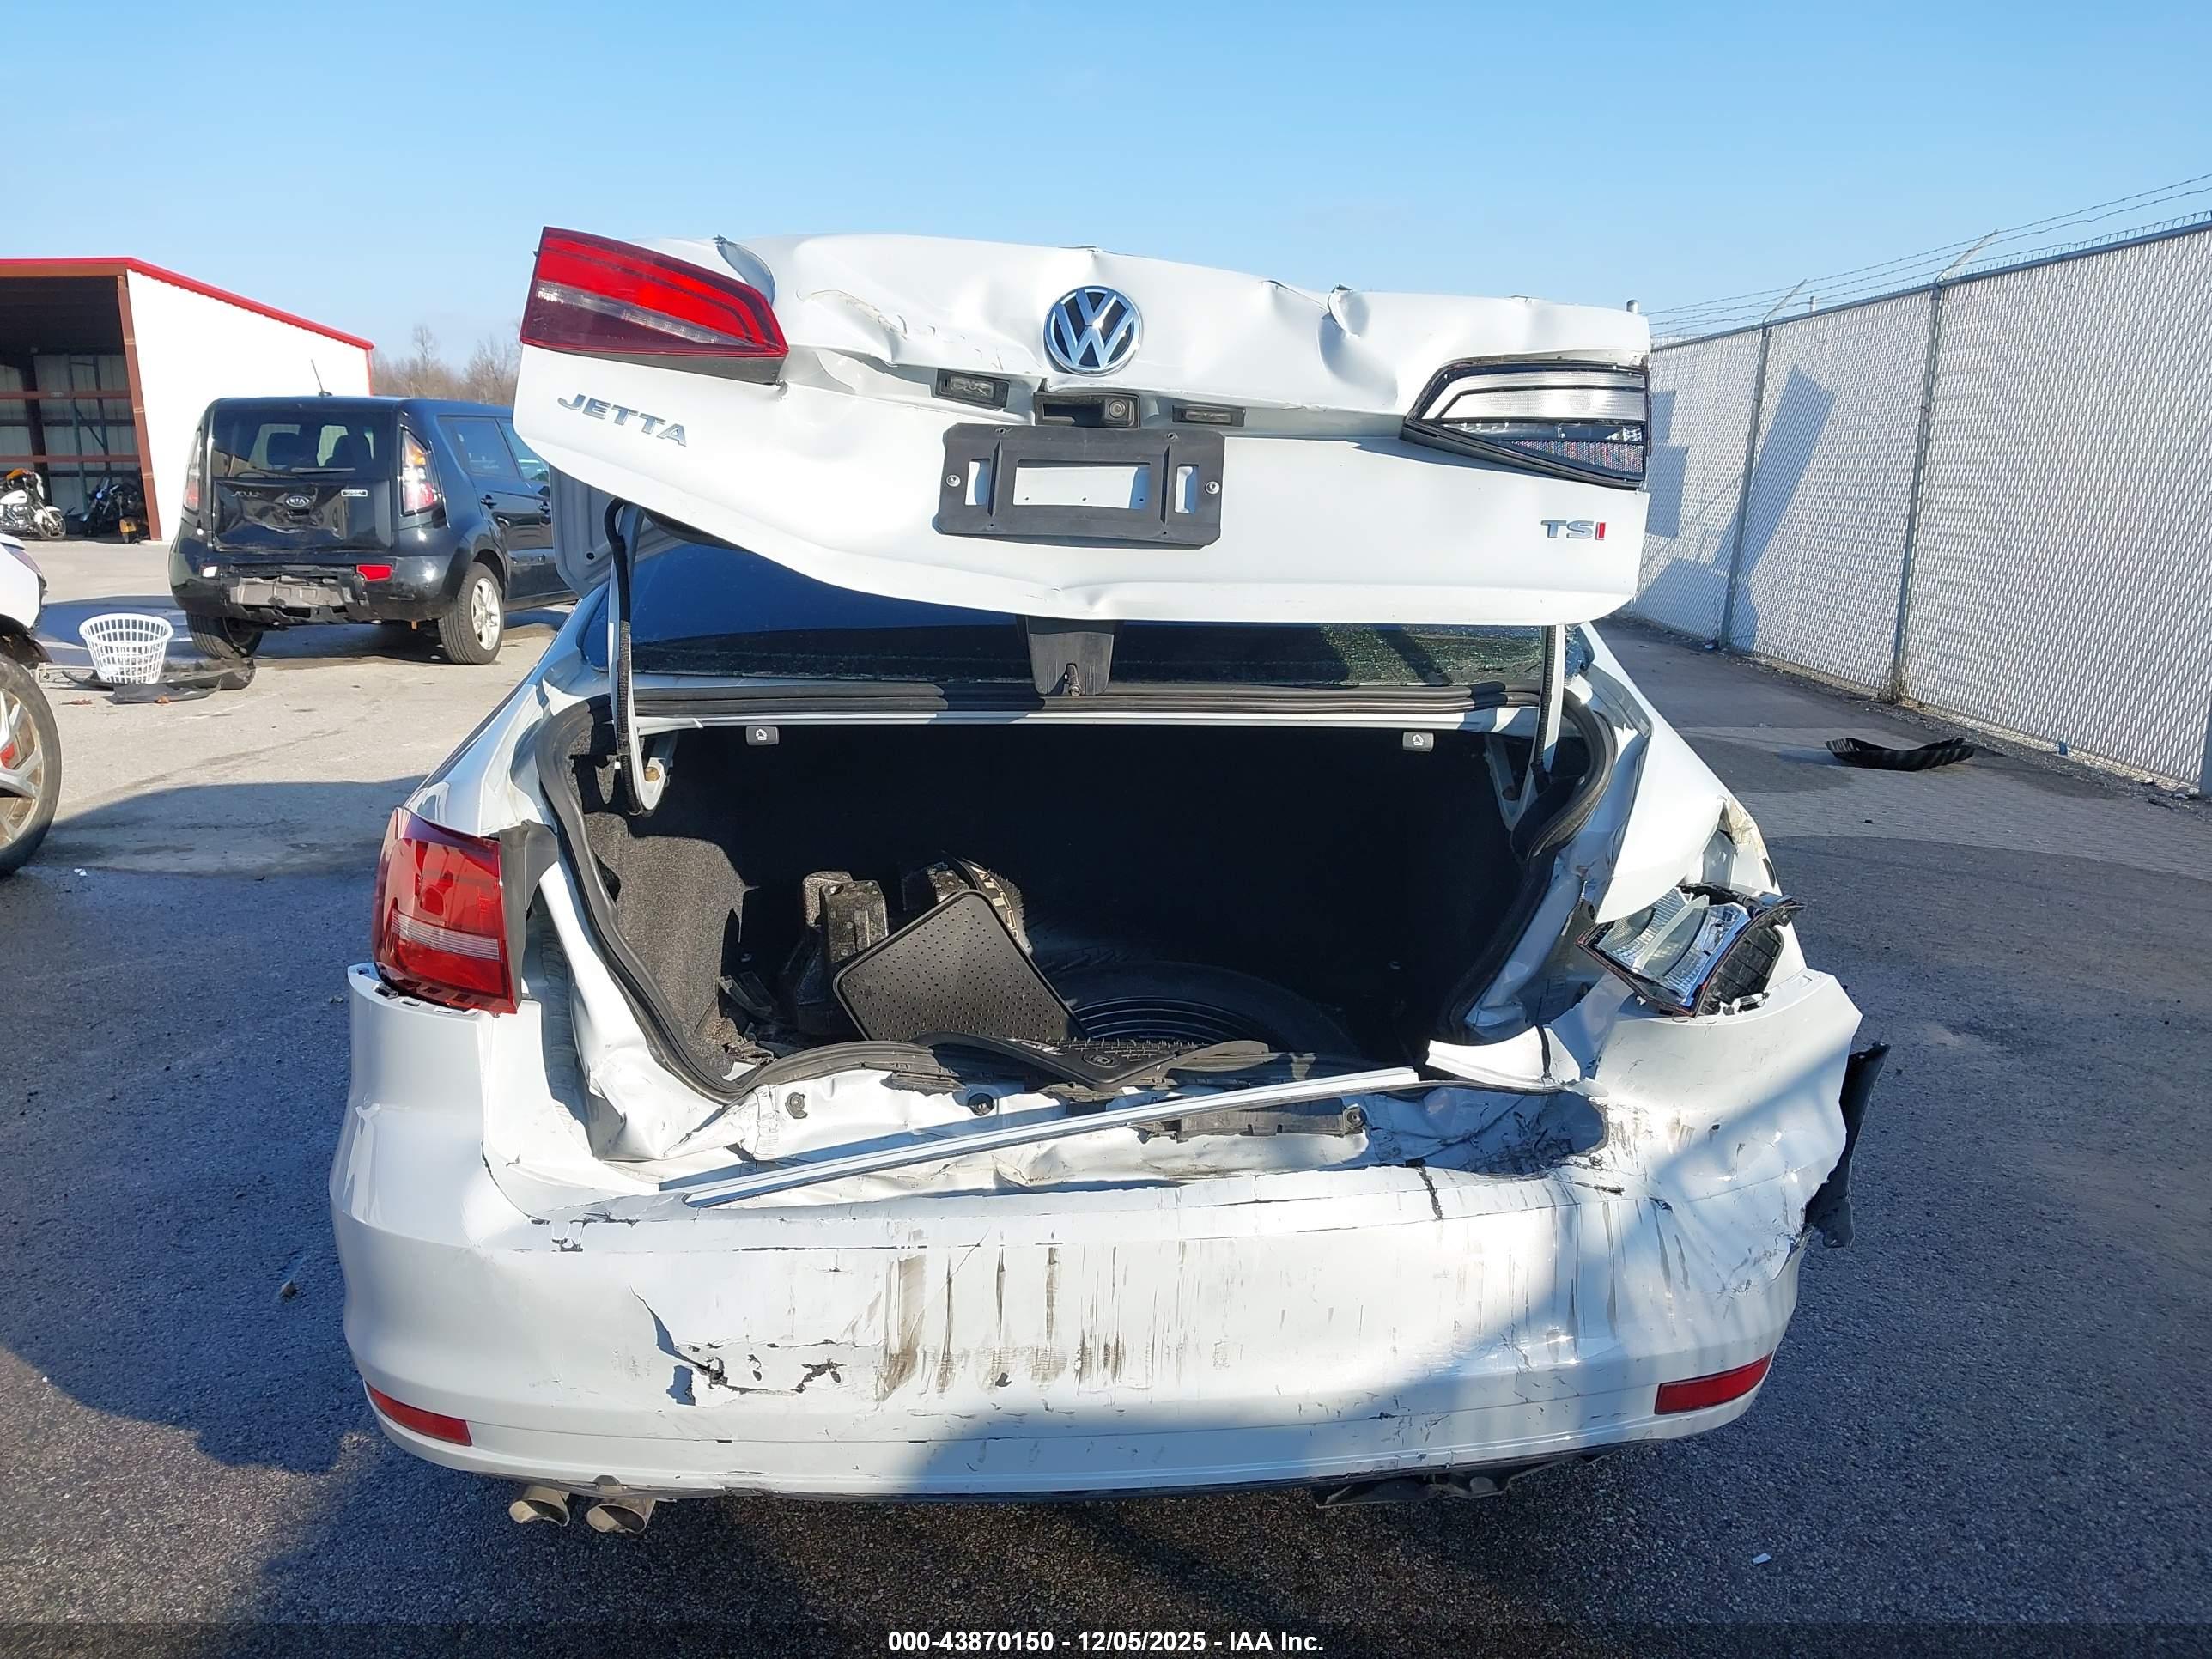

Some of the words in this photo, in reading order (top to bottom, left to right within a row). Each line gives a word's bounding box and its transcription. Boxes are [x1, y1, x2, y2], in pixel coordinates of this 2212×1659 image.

[1046, 287, 1140, 374] VW
[557, 393, 687, 447] JETTA
[1540, 520, 1607, 540] TSI
